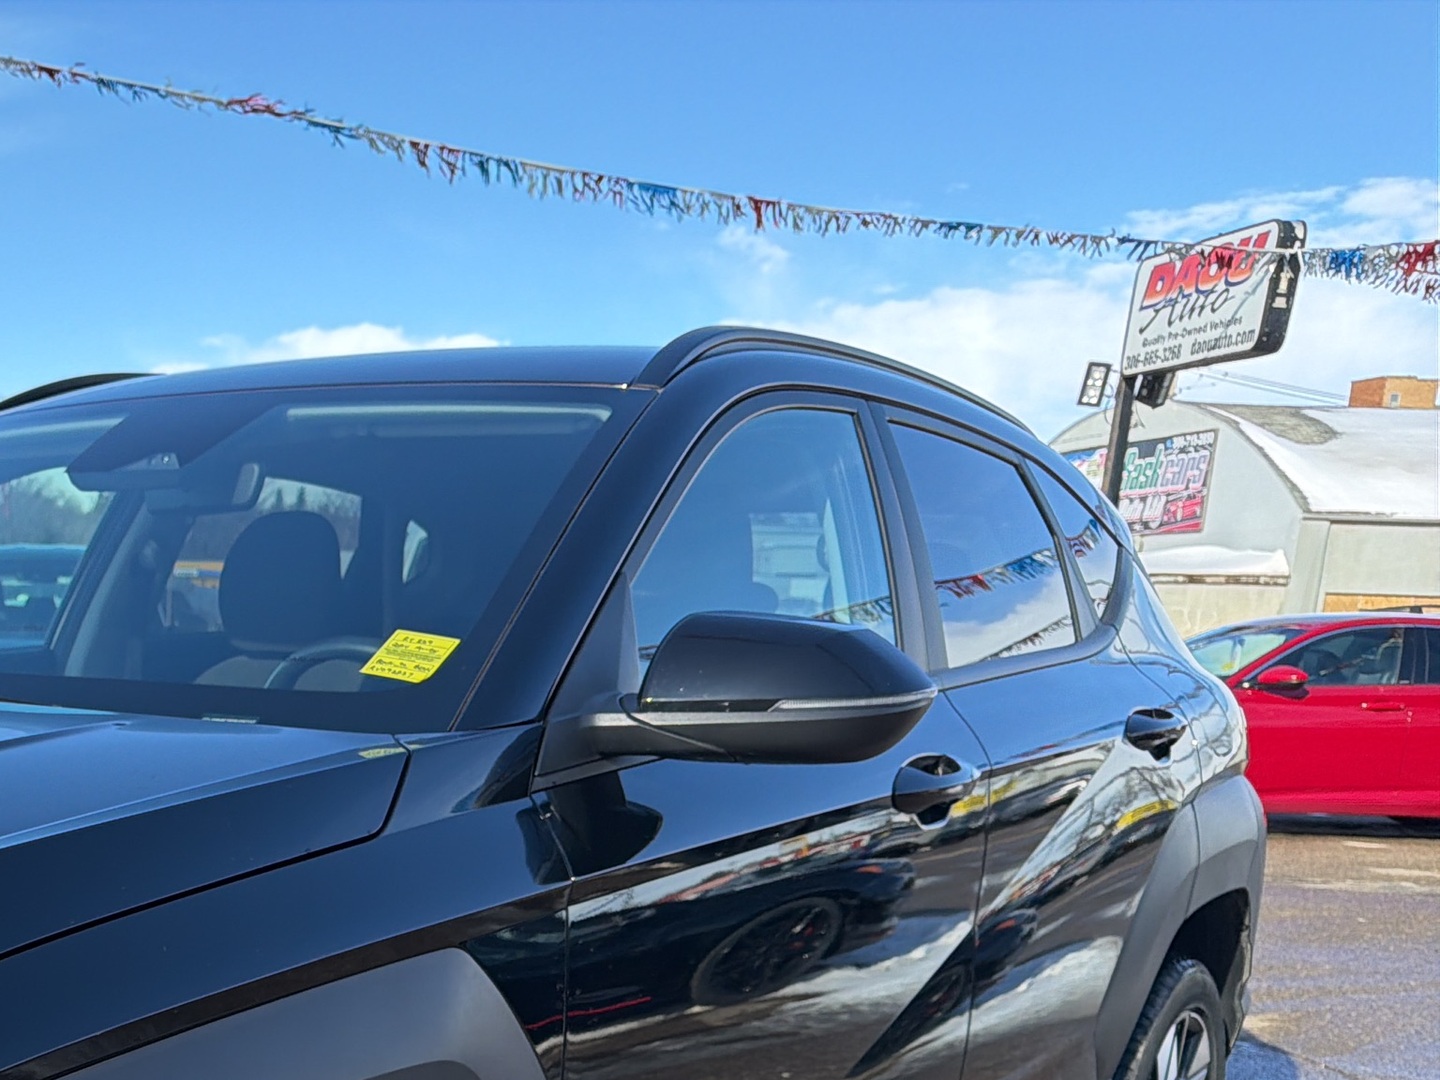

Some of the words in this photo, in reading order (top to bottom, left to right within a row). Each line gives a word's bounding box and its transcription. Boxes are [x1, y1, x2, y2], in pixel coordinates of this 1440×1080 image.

[1139, 231, 1271, 311] DAOU
[1139, 289, 1236, 334] Auto
[1142, 333, 1166, 349] Quality
[1167, 322, 1208, 342] Pre-Owned
[1210, 315, 1243, 331] Vehicles
[1190, 329, 1256, 355] daouauto.com
